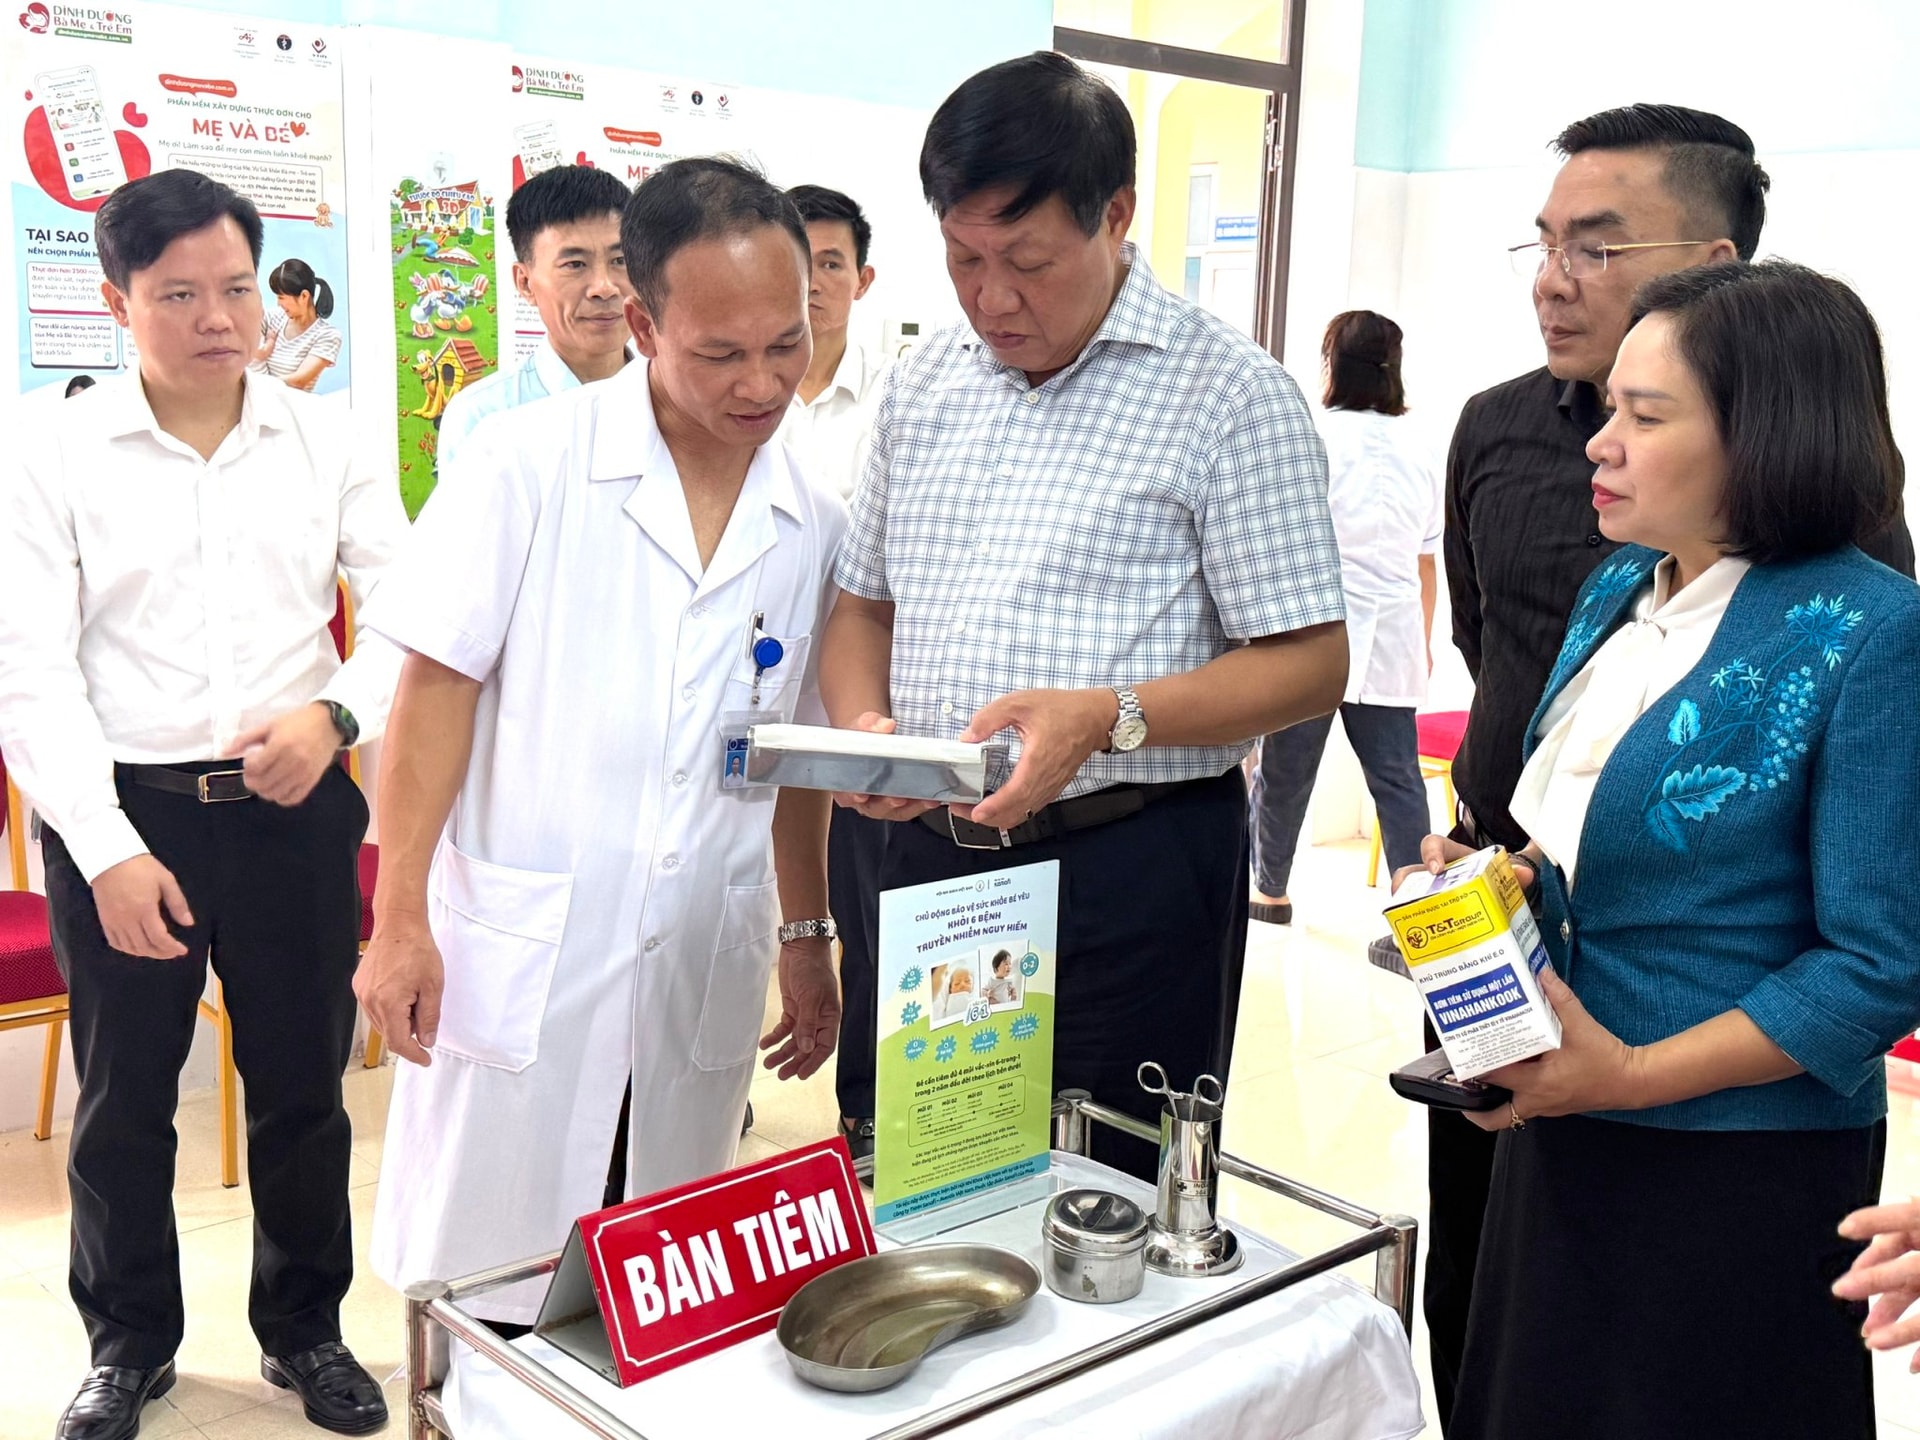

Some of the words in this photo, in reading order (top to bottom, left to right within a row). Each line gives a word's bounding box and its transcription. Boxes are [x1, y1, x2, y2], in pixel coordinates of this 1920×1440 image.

[53, 5, 84, 18] DINH
[54, 16, 68, 26] Bà
[96, 21, 113, 32] Trẻ
[116, 24, 132, 34] Em
[192, 118, 223, 142] MẸ
[229, 118, 259, 140] VÀ
[265, 122, 291, 143] BÉ
[25, 228, 51, 244] TẠI
[56, 230, 89, 243] SAO
[915, 912, 930, 922] CHỦ
[931, 909, 950, 920] ĐỘNG
[952, 904, 966, 915] BẢO
[966, 902, 976, 913] VỆ
[976, 900, 990, 910] SỨC
[990, 896, 1008, 907] KHỎE
[1008, 893, 1017, 904] BÉ
[1018, 891, 1030, 901] YÊU
[948, 915, 970, 930] KHỎI
[972, 916, 976, 924] 6
[978, 911, 1002, 924] BỆNH
[916, 933, 952, 954] TRUYỀN
[952, 926, 981, 942] NHIỄM
[982, 923, 1006, 936] NGUY
[1006, 920, 1028, 932] HIỂM
[1438, 986, 1522, 1025] VINAHANKOOK
[623, 1229, 735, 1327] BÀN
[733, 1188, 851, 1284] TIÊM
